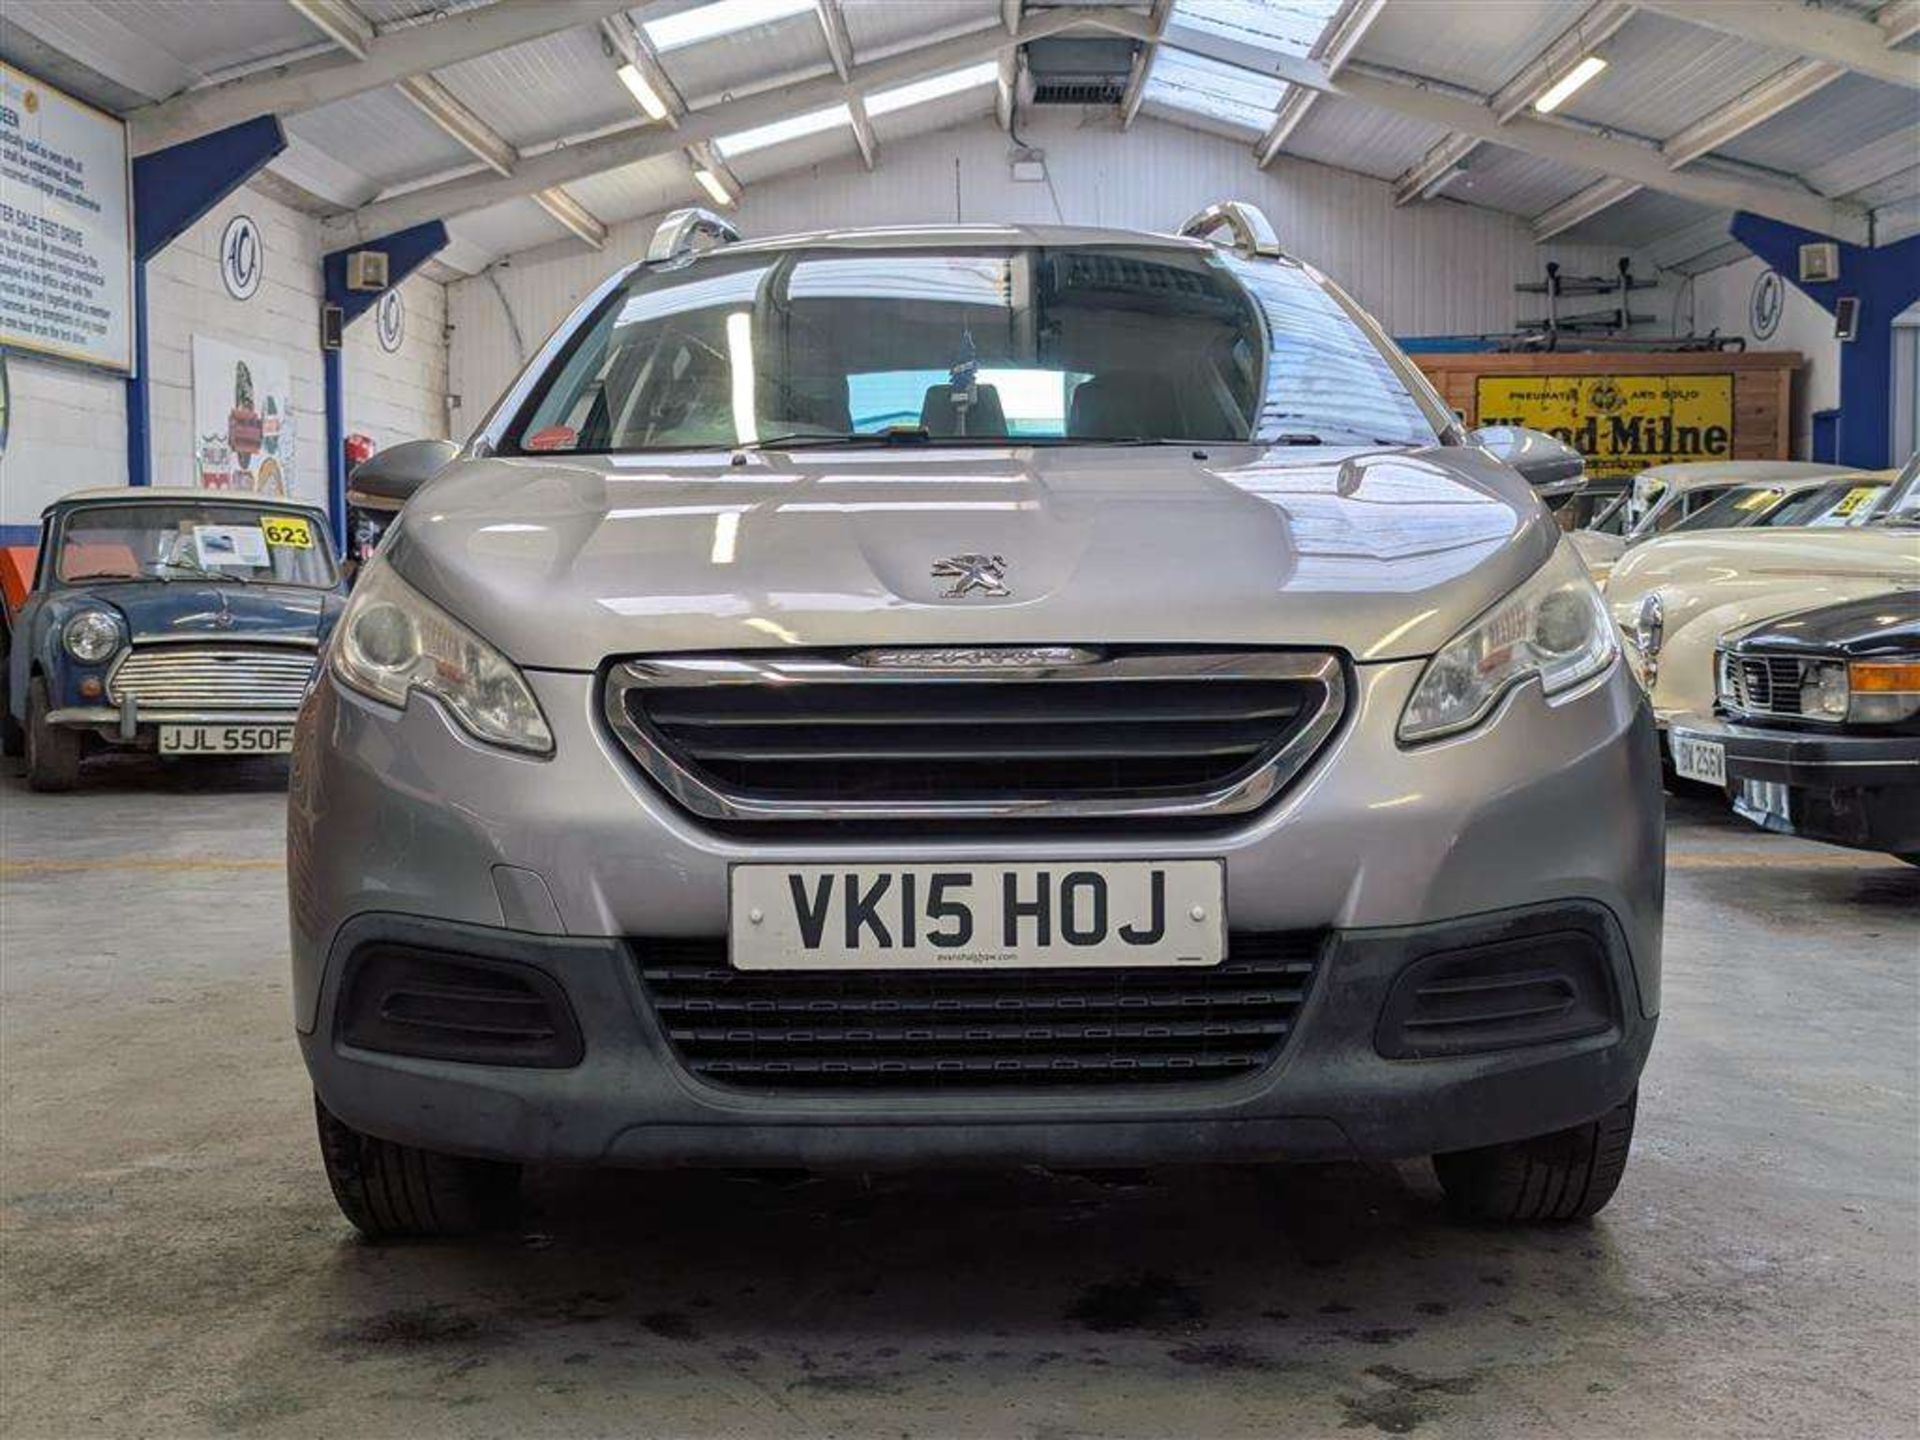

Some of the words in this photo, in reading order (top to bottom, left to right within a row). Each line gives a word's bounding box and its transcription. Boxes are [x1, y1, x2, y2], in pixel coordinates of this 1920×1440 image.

[266, 526, 309, 545] 623
[164, 729, 216, 750] JJL
[223, 729, 291, 750] 550F
[788, 872, 973, 949] VK15
[1003, 871, 1165, 947] HOJ
